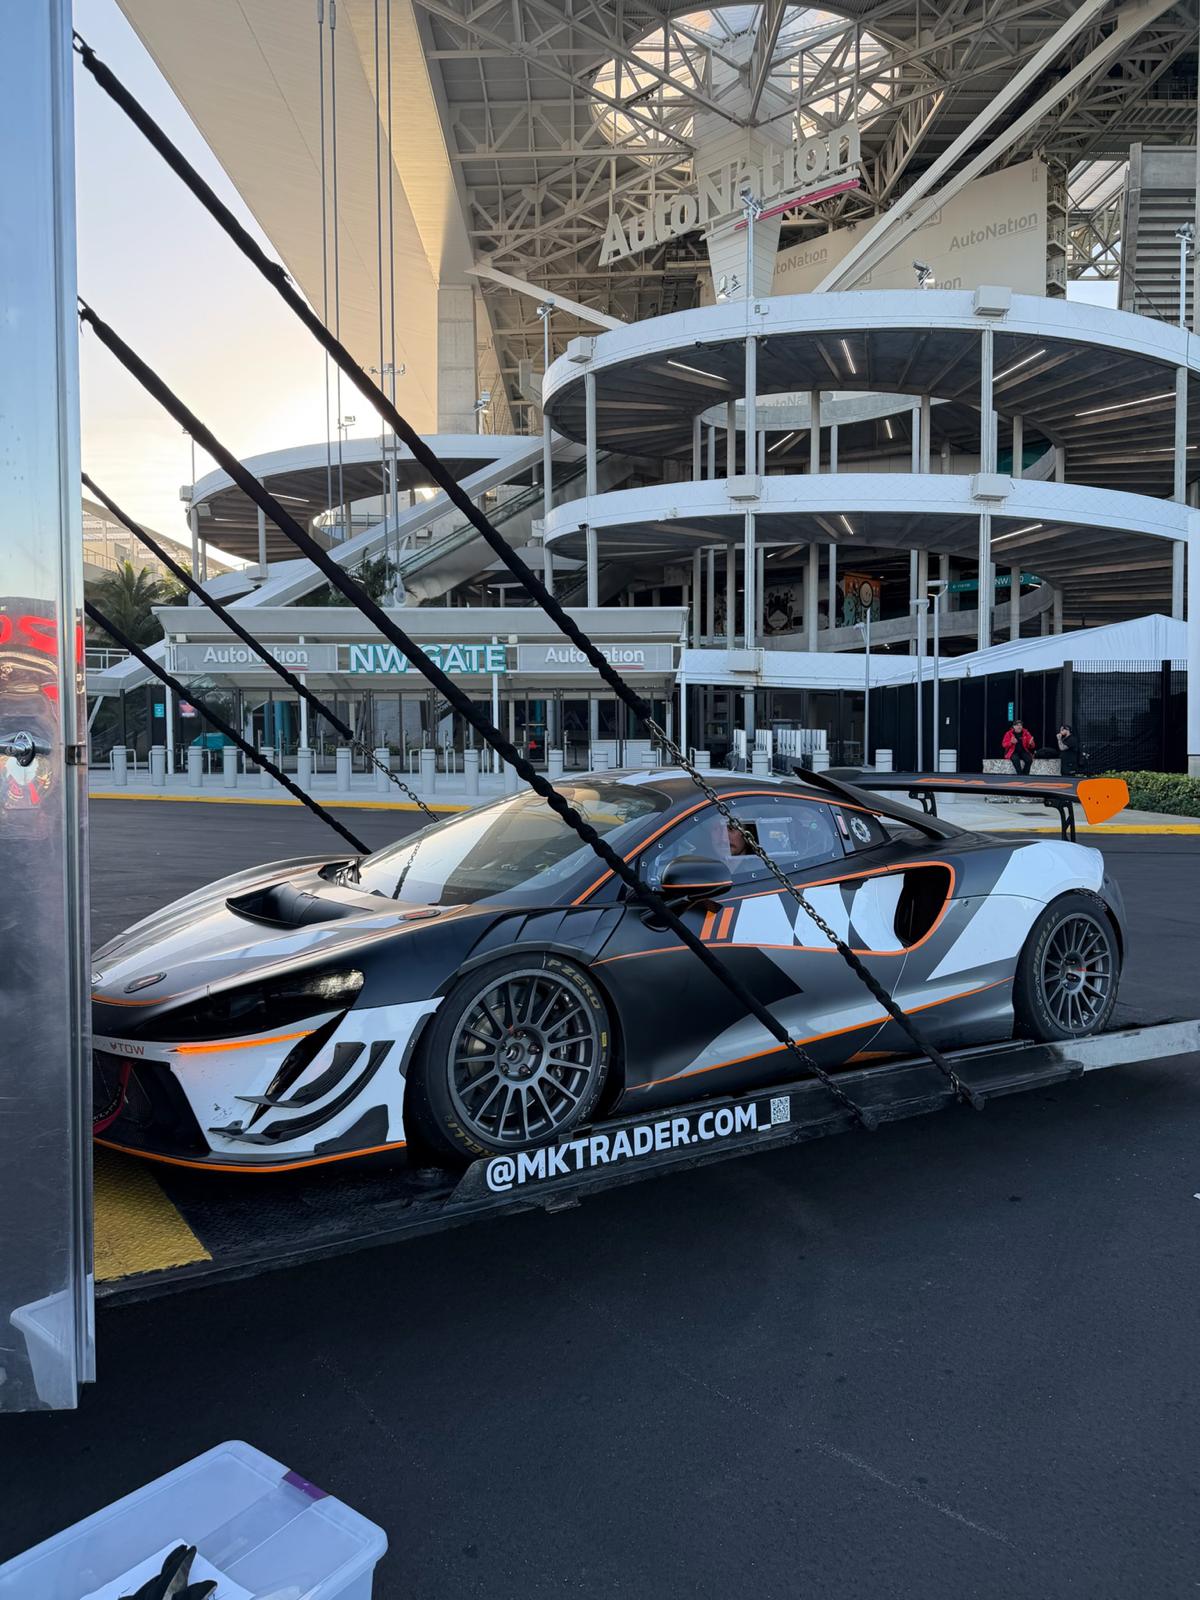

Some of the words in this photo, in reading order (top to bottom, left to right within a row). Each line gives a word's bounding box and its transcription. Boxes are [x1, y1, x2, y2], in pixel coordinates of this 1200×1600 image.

[598, 121, 861, 266] AutoNation
[949, 212, 1038, 252] AutoNation
[774, 247, 828, 275] toNation
[545, 646, 645, 663] Autoation
[561, 964, 601, 1010] ZERO
[118, 1043, 145, 1056] TOW
